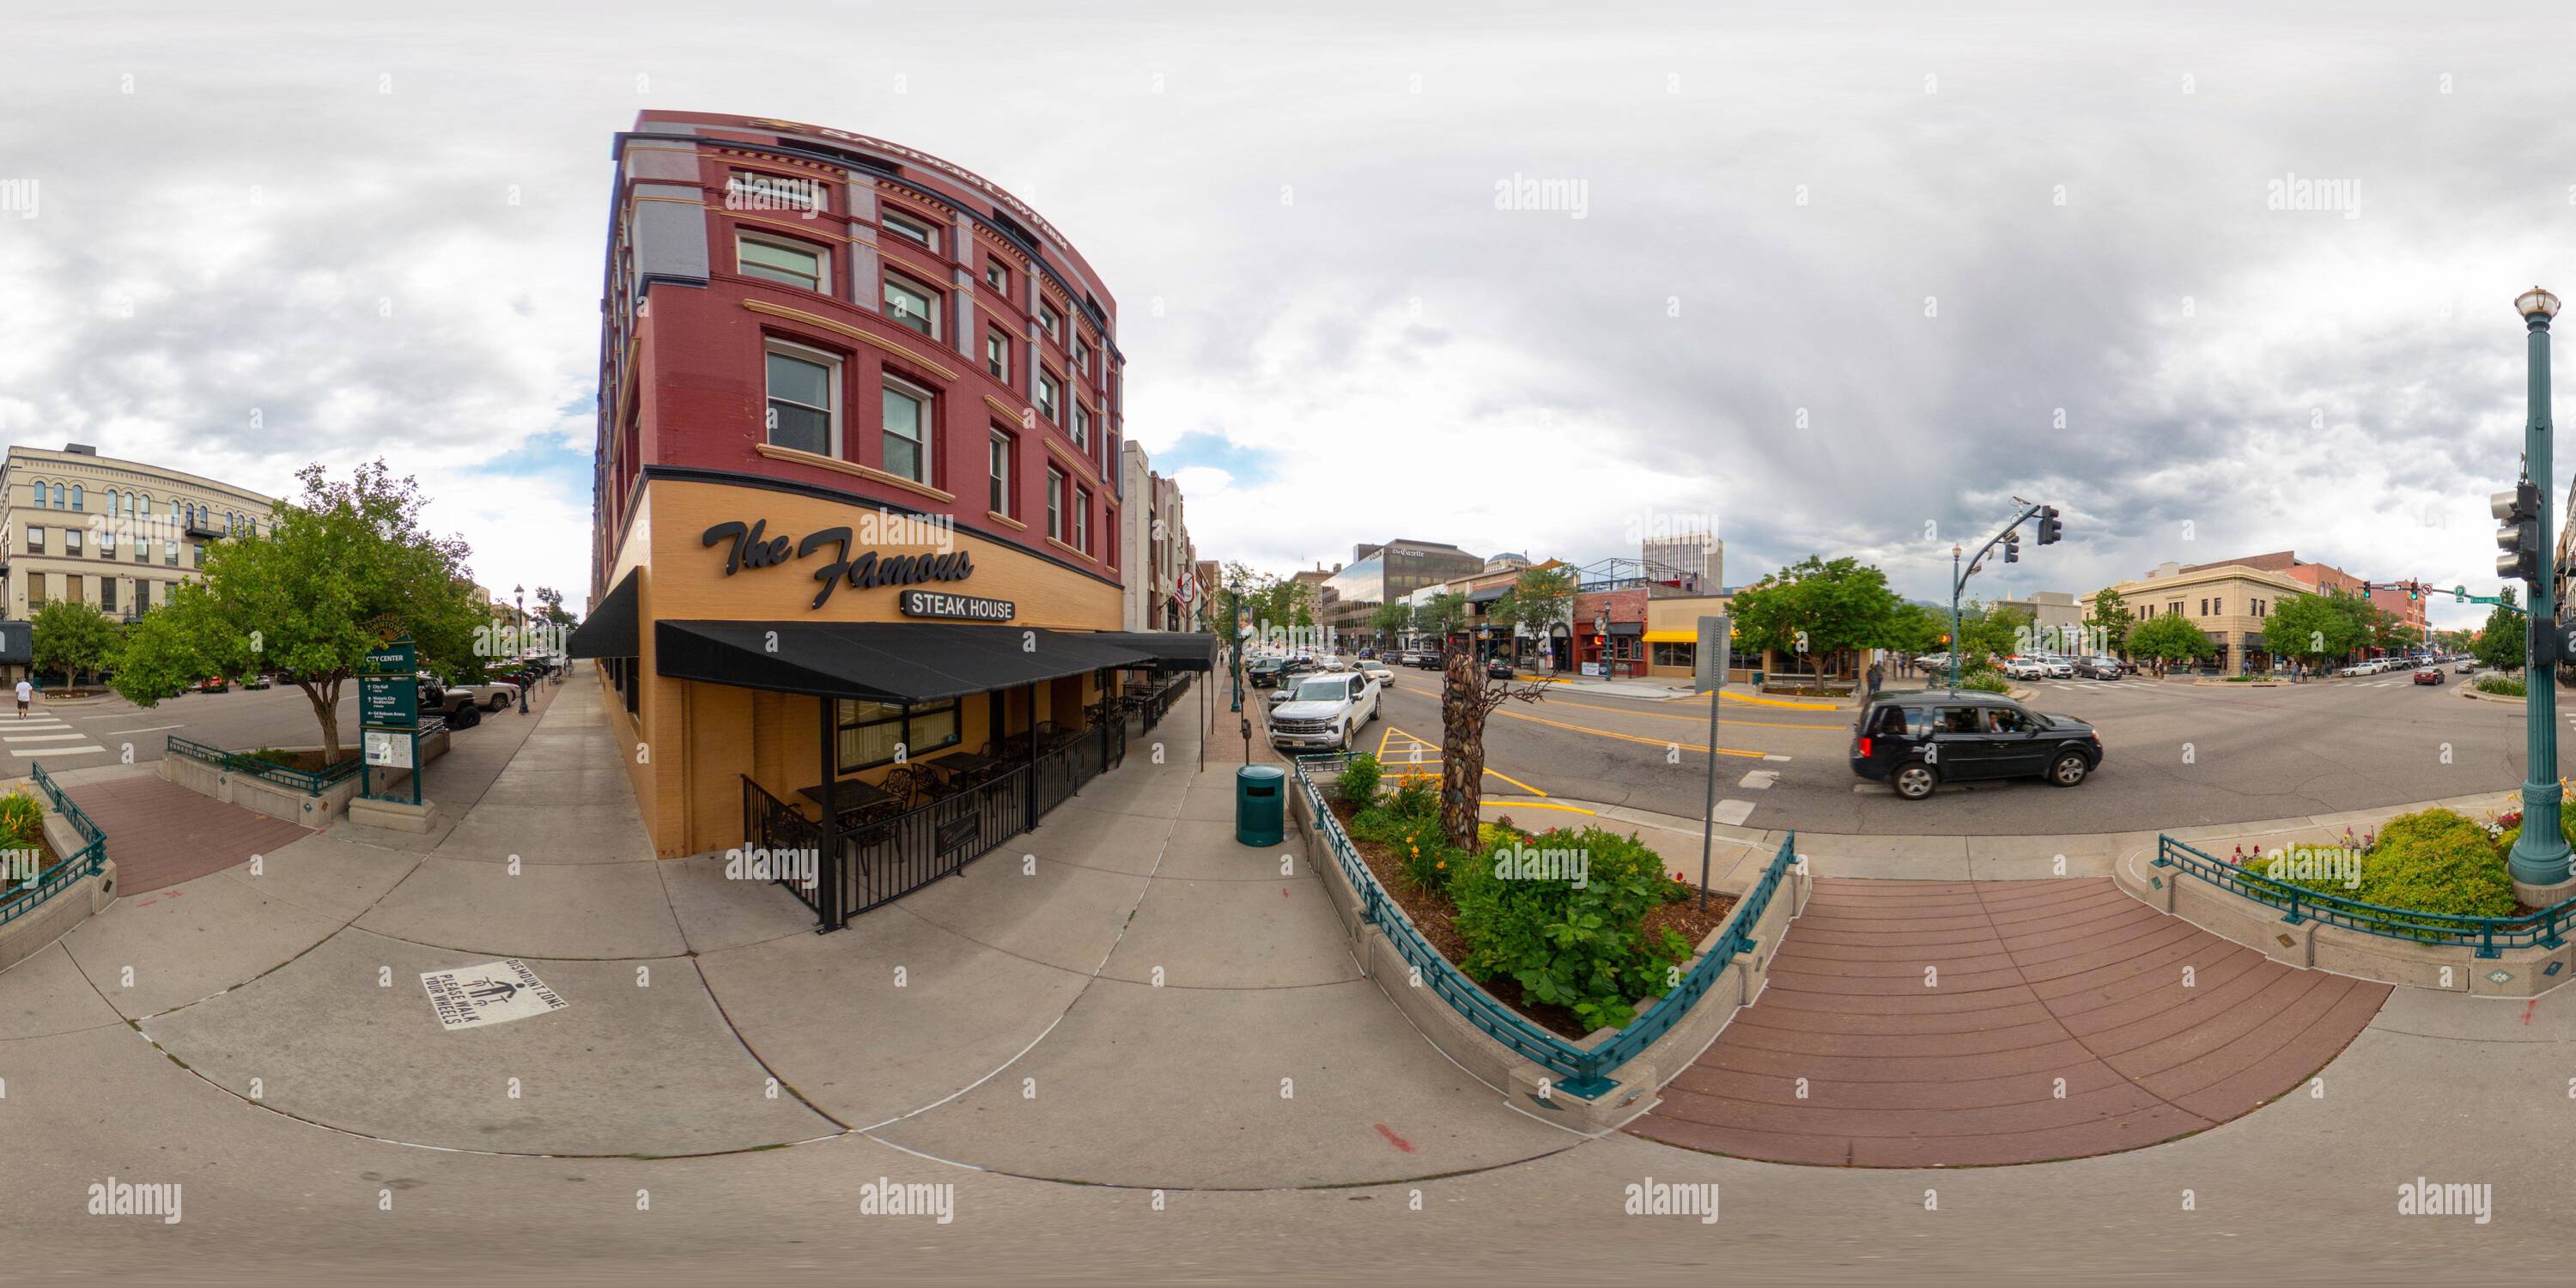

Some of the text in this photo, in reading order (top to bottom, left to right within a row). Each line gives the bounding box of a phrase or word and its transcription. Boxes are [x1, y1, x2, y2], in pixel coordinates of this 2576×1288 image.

[820, 129, 1069, 251] SANDERS LAW FIRM
[702, 519, 975, 610] The Famous
[912, 592, 1012, 618] STEAK HOUSE
[425, 976, 462, 1024] YOUR WHEELS
[440, 974, 481, 1023] PLEASE WALK
[506, 959, 567, 1009] DISMOUNT ZONE
